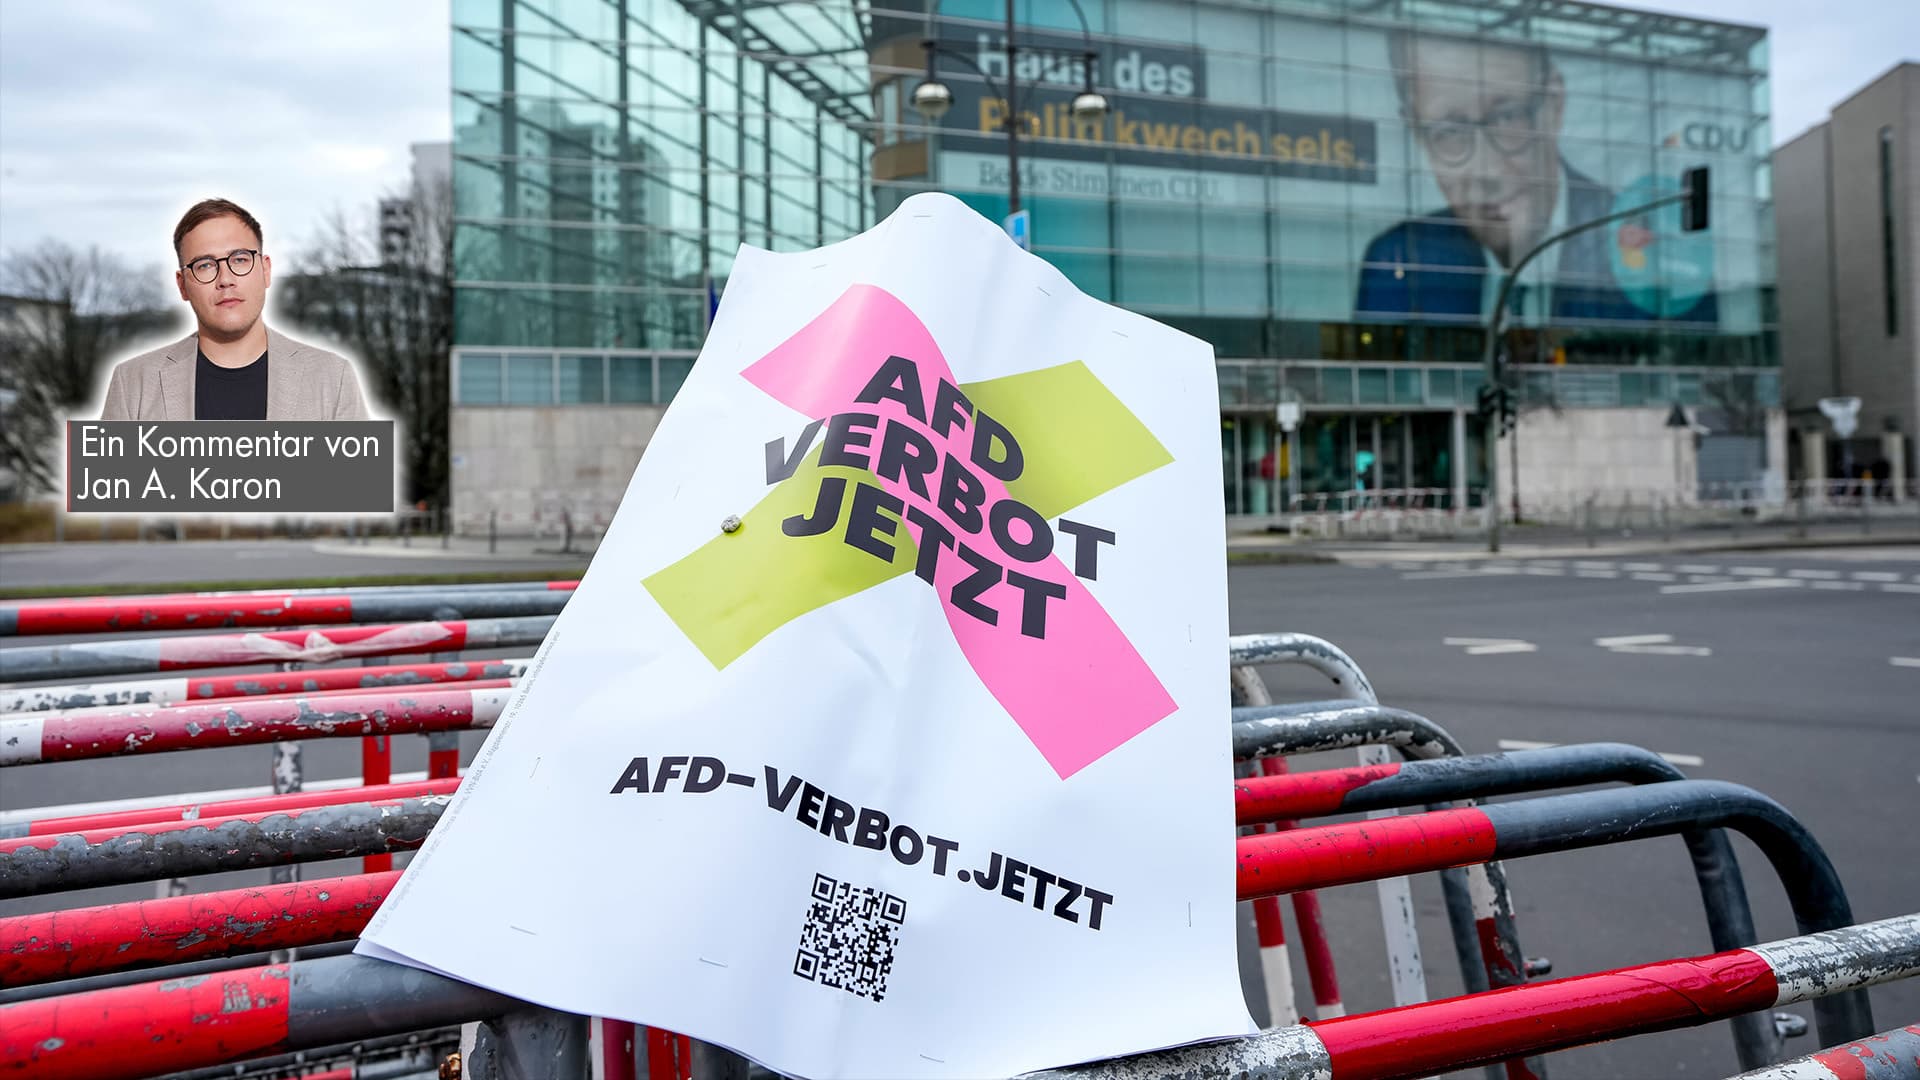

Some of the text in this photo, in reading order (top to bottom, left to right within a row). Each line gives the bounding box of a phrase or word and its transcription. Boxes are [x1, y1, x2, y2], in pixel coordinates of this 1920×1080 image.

[1114, 51, 1194, 96] des
[978, 160, 1047, 190] Bede
[1685, 124, 1748, 153] CDU
[853, 355, 1024, 482] AFD
[765, 412, 1116, 581] VERBOT
[781, 477, 1066, 640] JETZT
[610, 756, 1113, 930] AFD-VERBOT.JETZT
